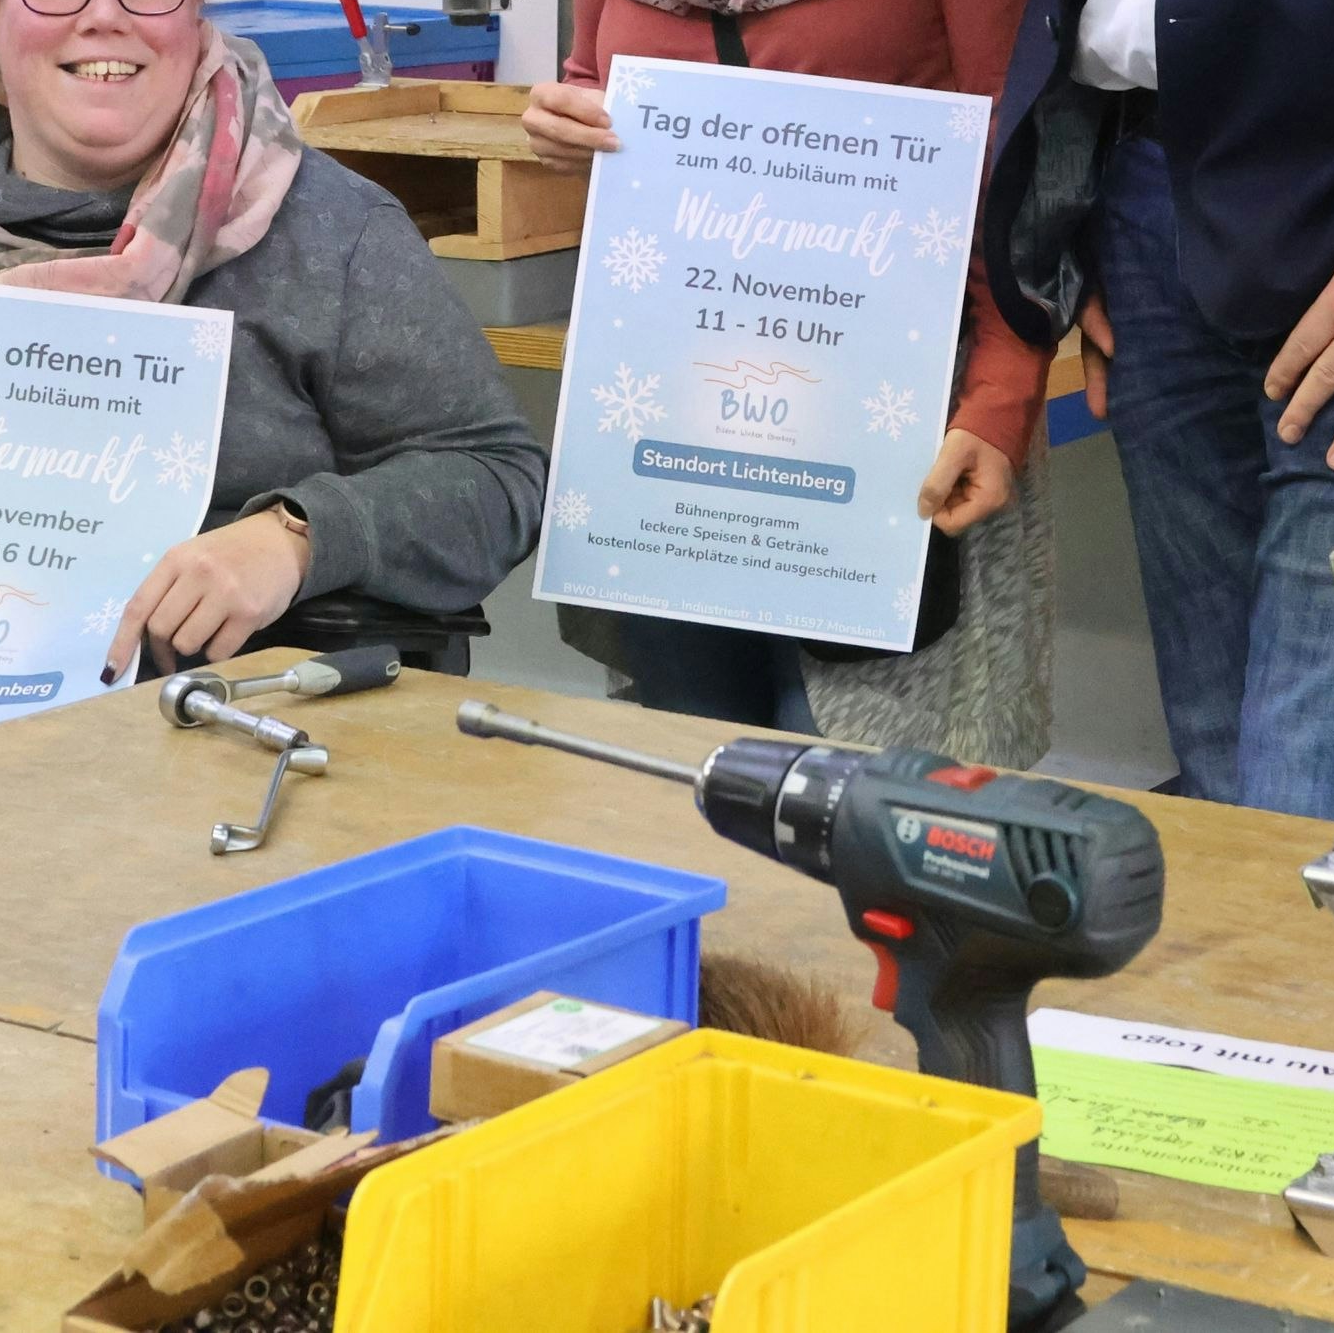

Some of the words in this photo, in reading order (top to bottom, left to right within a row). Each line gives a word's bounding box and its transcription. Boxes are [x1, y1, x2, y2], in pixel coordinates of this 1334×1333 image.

[638, 105, 690, 139] Tag
[702, 114, 753, 140] der
[762, 123, 878, 156] offenen
[891, 135, 941, 163] Tür
[676, 154, 718, 169] zum
[726, 156, 756, 174] 40.
[763, 160, 856, 186] Jubiläum
[864, 174, 898, 191] mit
[674, 188, 903, 276] Wintermarkt
[685, 267, 722, 291] 22.
[733, 273, 865, 308] November
[695, 308, 726, 332] 11
[757, 316, 788, 339] 16
[797, 321, 844, 346] Uhr
[6, 343, 121, 378] offenen
[134, 354, 184, 384] Tür
[5, 383, 99, 410] Jubiläum
[108, 396, 141, 415] mit
[720, 390, 788, 426] BWO
[642, 449, 726, 476] Standort
[732, 461, 846, 496] Lichtenberg
[675, 503, 799, 530] Bühnenprogramm
[641, 519, 688, 536] leckere
[693, 527, 746, 544] Speisen
[751, 534, 761, 546] &
[766, 537, 828, 555] Getränke
[28, 546, 77, 570] Uhr
[588, 532, 660, 553] kostenlose
[665, 544, 738, 564] Parkplätze
[742, 554, 771, 569] sind
[775, 562, 876, 584] ausgeschildert
[563, 583, 597, 597] BWO
[599, 588, 669, 610] Lichtenberg
[682, 599, 753, 620] Industriestr.
[827, 620, 886, 638] Morsbach
[926, 825, 996, 862] BOSCH
[1121, 1033, 1204, 1053] Logo
[1213, 1049, 1274, 1065] mit
[1091, 1140, 1293, 1179] arenbegleitkarte
